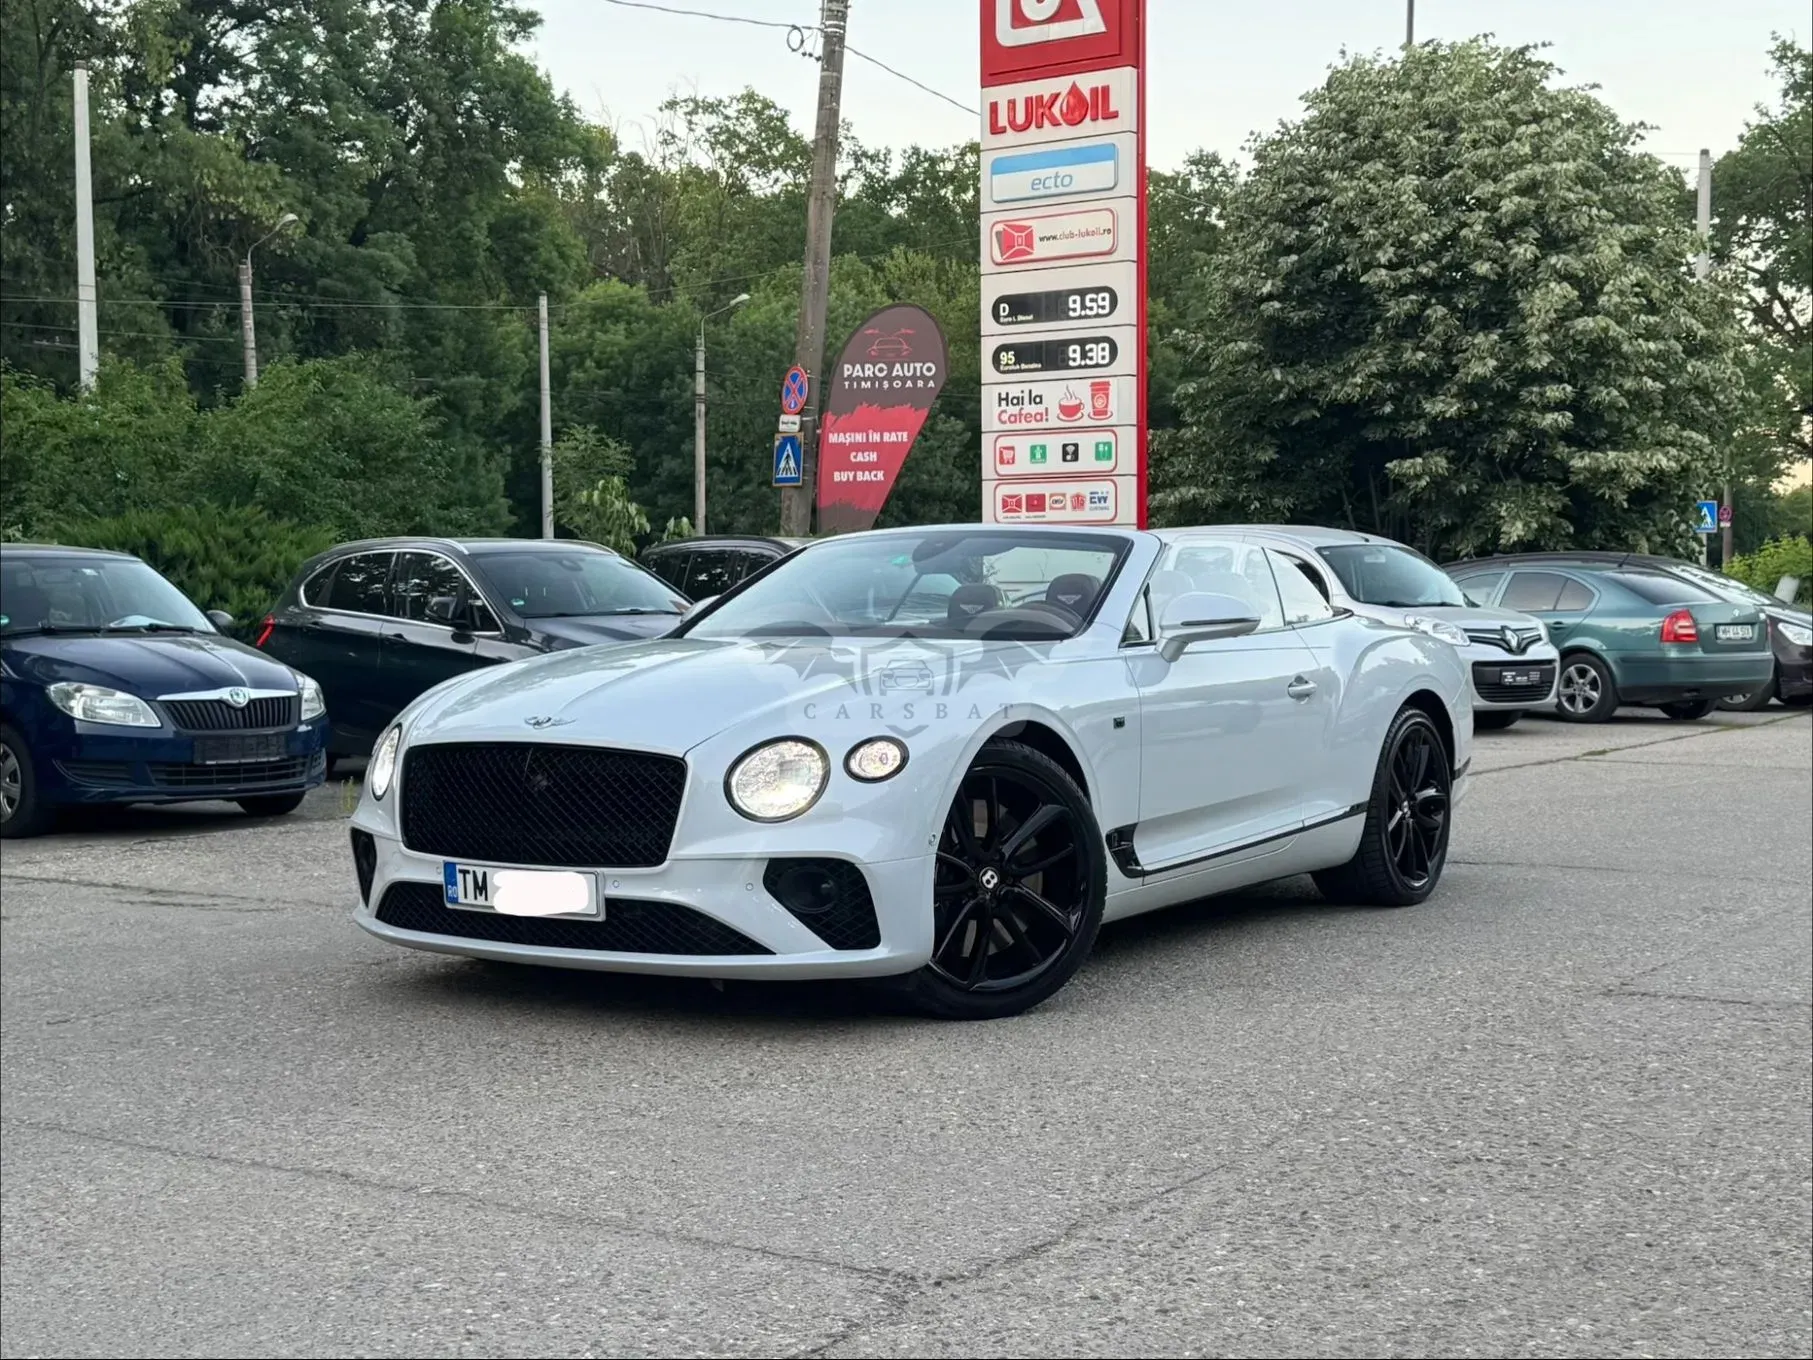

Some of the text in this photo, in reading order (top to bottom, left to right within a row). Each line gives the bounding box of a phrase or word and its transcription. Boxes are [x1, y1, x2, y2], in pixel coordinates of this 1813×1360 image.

[989, 81, 1119, 135] LUKOIL
[1030, 171, 1073, 191] ecto
[999, 292, 1110, 317] D 9.59
[1000, 342, 1110, 367] 95 9.38
[843, 362, 936, 378] PARC AUTO
[844, 380, 936, 390] TIMIȘOARA
[998, 388, 1043, 407] Hai la
[998, 407, 1049, 424] Cafea!
[828, 429, 909, 446] MAȘINI ÎN RATE
[850, 451, 878, 463] CASH
[833, 470, 885, 482] BUY BACK
[458, 869, 489, 901] TM
